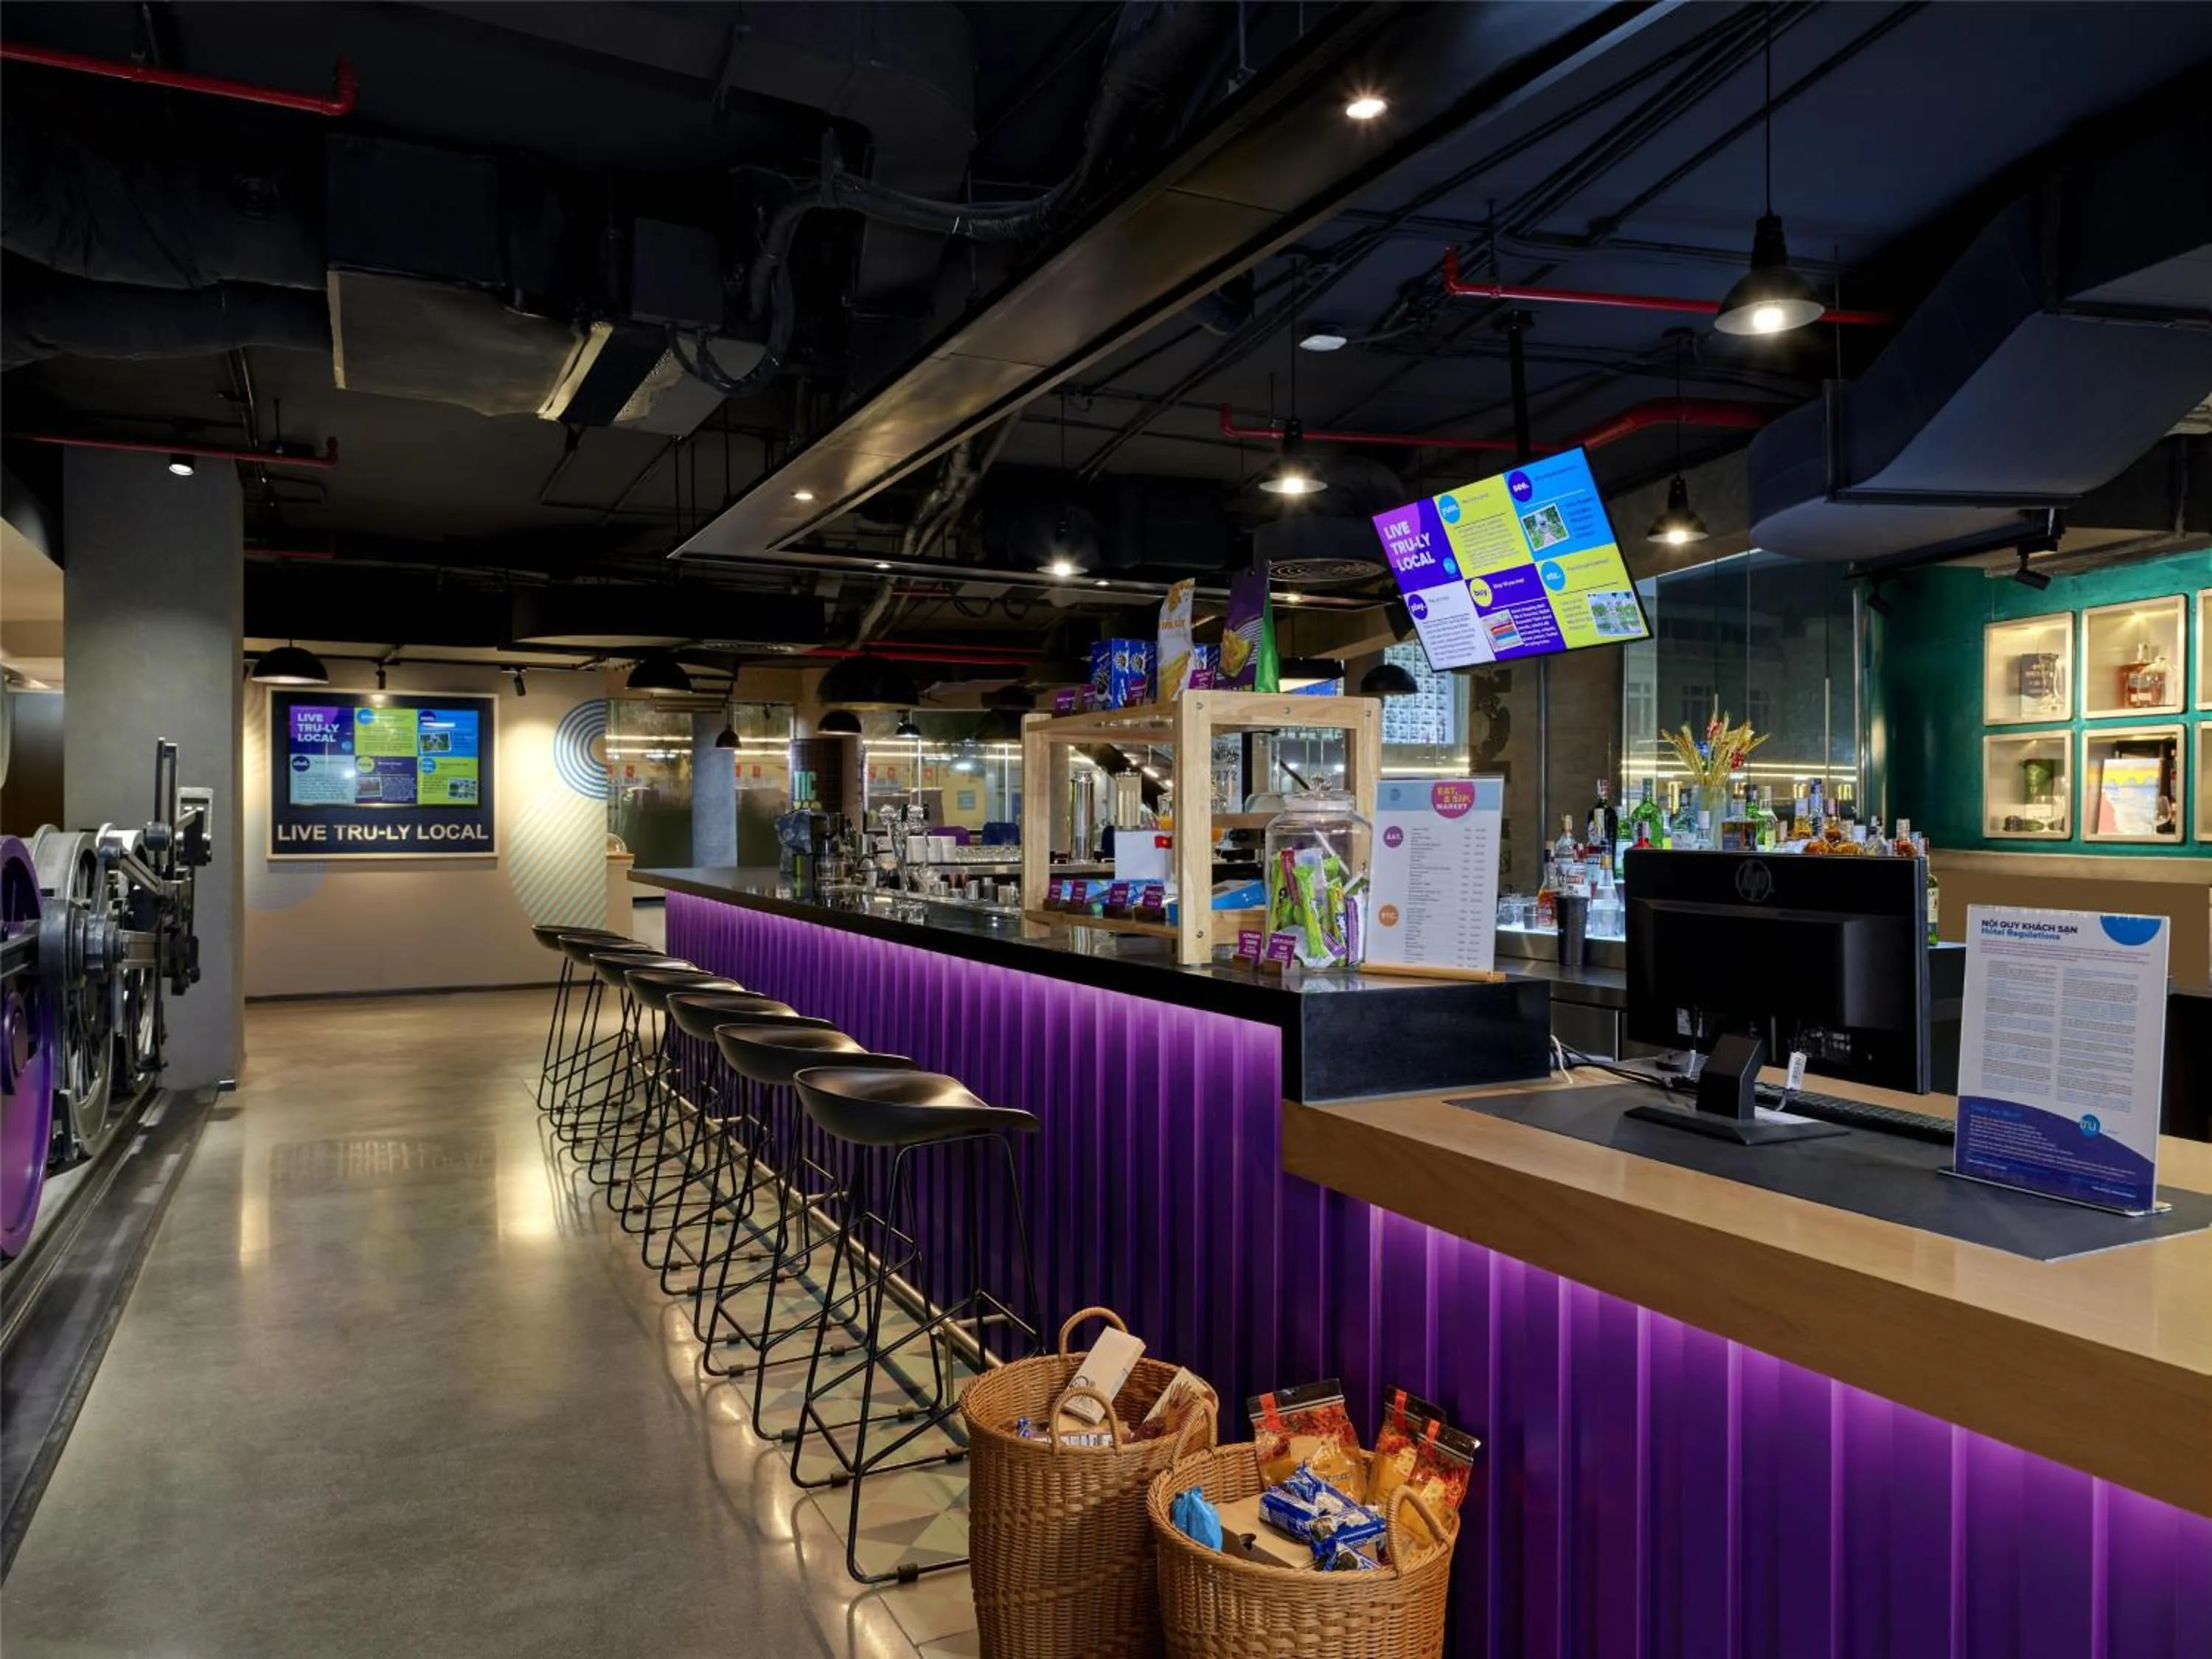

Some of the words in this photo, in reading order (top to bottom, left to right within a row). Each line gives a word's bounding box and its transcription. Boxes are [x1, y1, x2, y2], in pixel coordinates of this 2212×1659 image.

[1383, 521, 1411, 540] LIVE
[1390, 532, 1431, 555] TRU-LY
[1397, 551, 1436, 571] LOCAL
[297, 713, 324, 722] LIVE
[297, 723, 339, 733] TRU-LY
[297, 734, 336, 743] LOCAL
[277, 824, 327, 841] LIVE
[333, 824, 411, 841] TRU-LY
[417, 824, 488, 840] LOCAL
[1981, 928, 2005, 936] Hotel
[2006, 929, 2061, 939] Regulations
